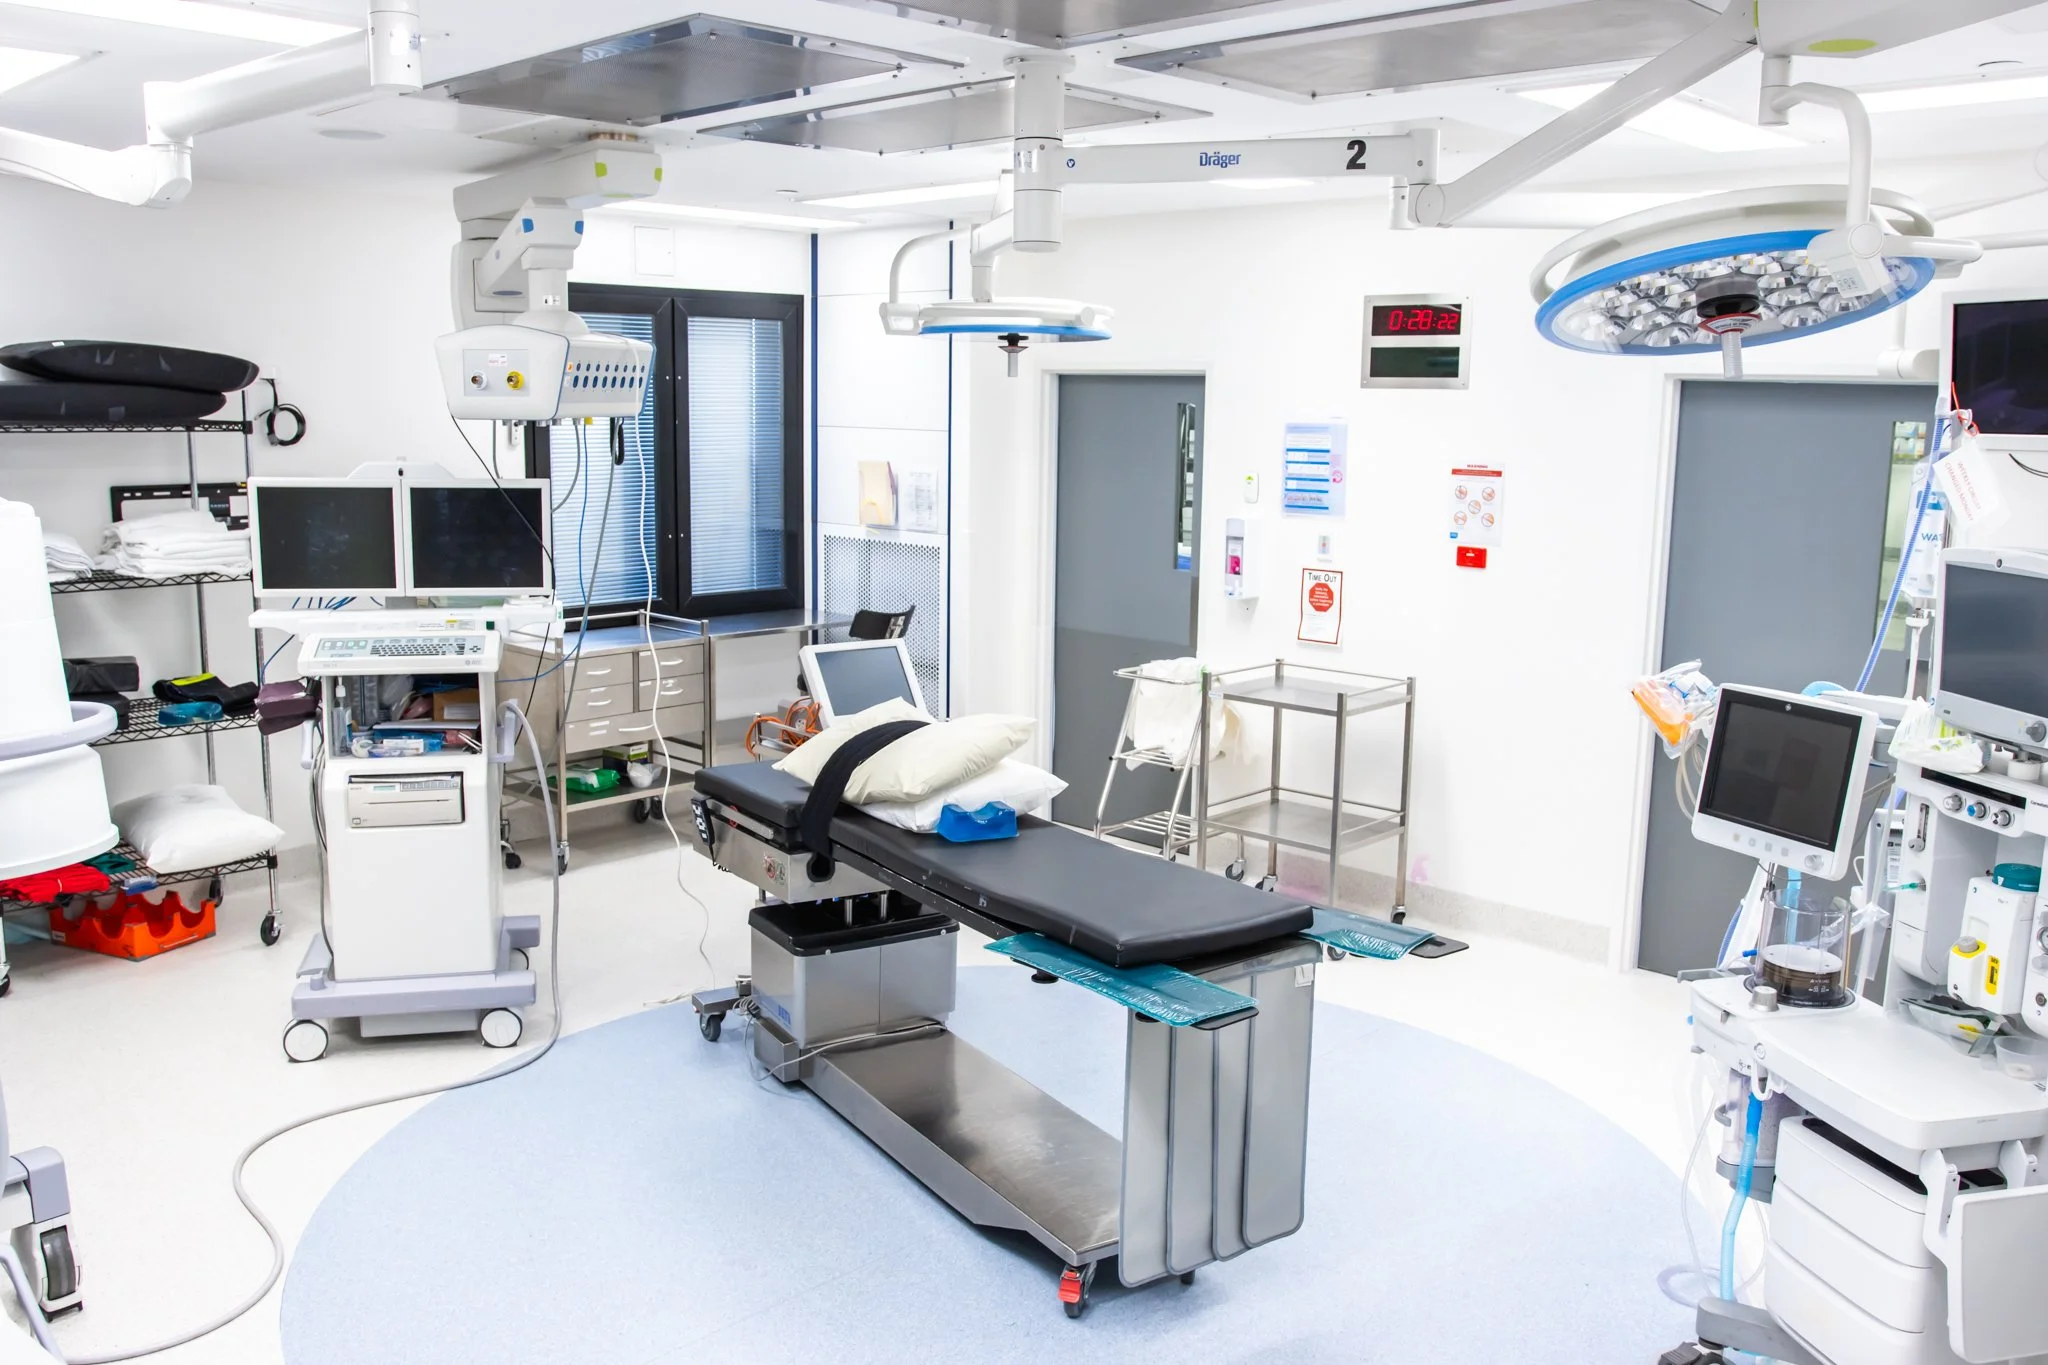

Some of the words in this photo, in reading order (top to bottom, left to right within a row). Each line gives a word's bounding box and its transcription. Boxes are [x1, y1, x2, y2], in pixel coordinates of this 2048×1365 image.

[1200, 152, 1241, 168] Dräger
[1346, 140, 1367, 170] 2
[1388, 309, 1459, 331] 0:28:22
